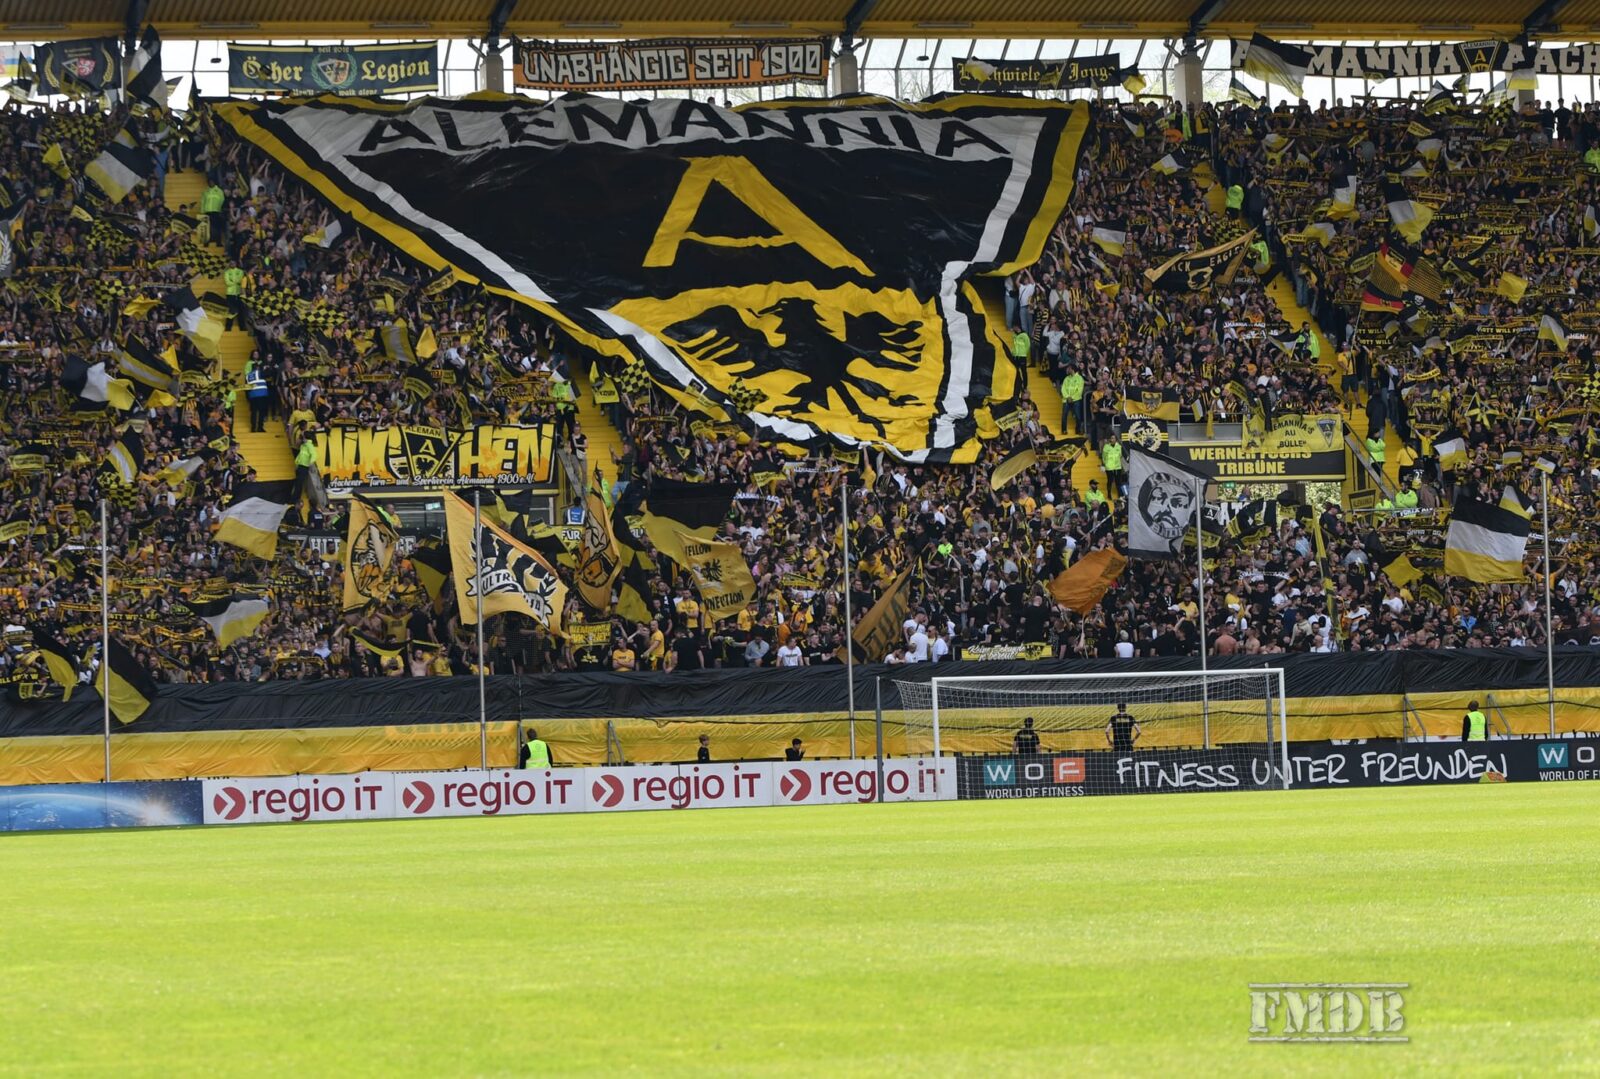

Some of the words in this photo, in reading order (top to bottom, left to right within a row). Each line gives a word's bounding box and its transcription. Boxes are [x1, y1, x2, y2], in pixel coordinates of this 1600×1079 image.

[242, 55, 304, 83] Öher
[361, 59, 430, 83] Legion
[521, 45, 689, 84] UNABHÄNGIG
[694, 47, 755, 80] SEIT
[761, 44, 822, 77] 1900
[1231, 39, 1461, 77] AMANNIA
[1474, 49, 1487, 64] A
[358, 98, 1012, 158] ALEMANNIA
[642, 154, 877, 270] A
[405, 425, 455, 442] ALEMANA
[418, 439, 437, 456] A
[1189, 447, 1256, 461] WERNER
[1217, 459, 1286, 475] TRIBÜNE
[497, 473, 519, 484] 1900
[482, 572, 511, 591] ULTR
[1116, 758, 1239, 789] FITNESS
[1361, 748, 1508, 784] FREUNDEN
[1539, 771, 1575, 782] WORLD
[1577, 769, 1593, 781] OF
[443, 772, 536, 815] regio
[545, 771, 573, 804] iT
[633, 766, 724, 809] regio
[733, 765, 761, 798] iT
[820, 766, 909, 803] rego
[985, 789, 1023, 799] WORLD
[1025, 788, 1041, 798] OF
[1042, 786, 1085, 798] FITNESS
[252, 778, 345, 821] regio
[354, 777, 382, 811] iT
